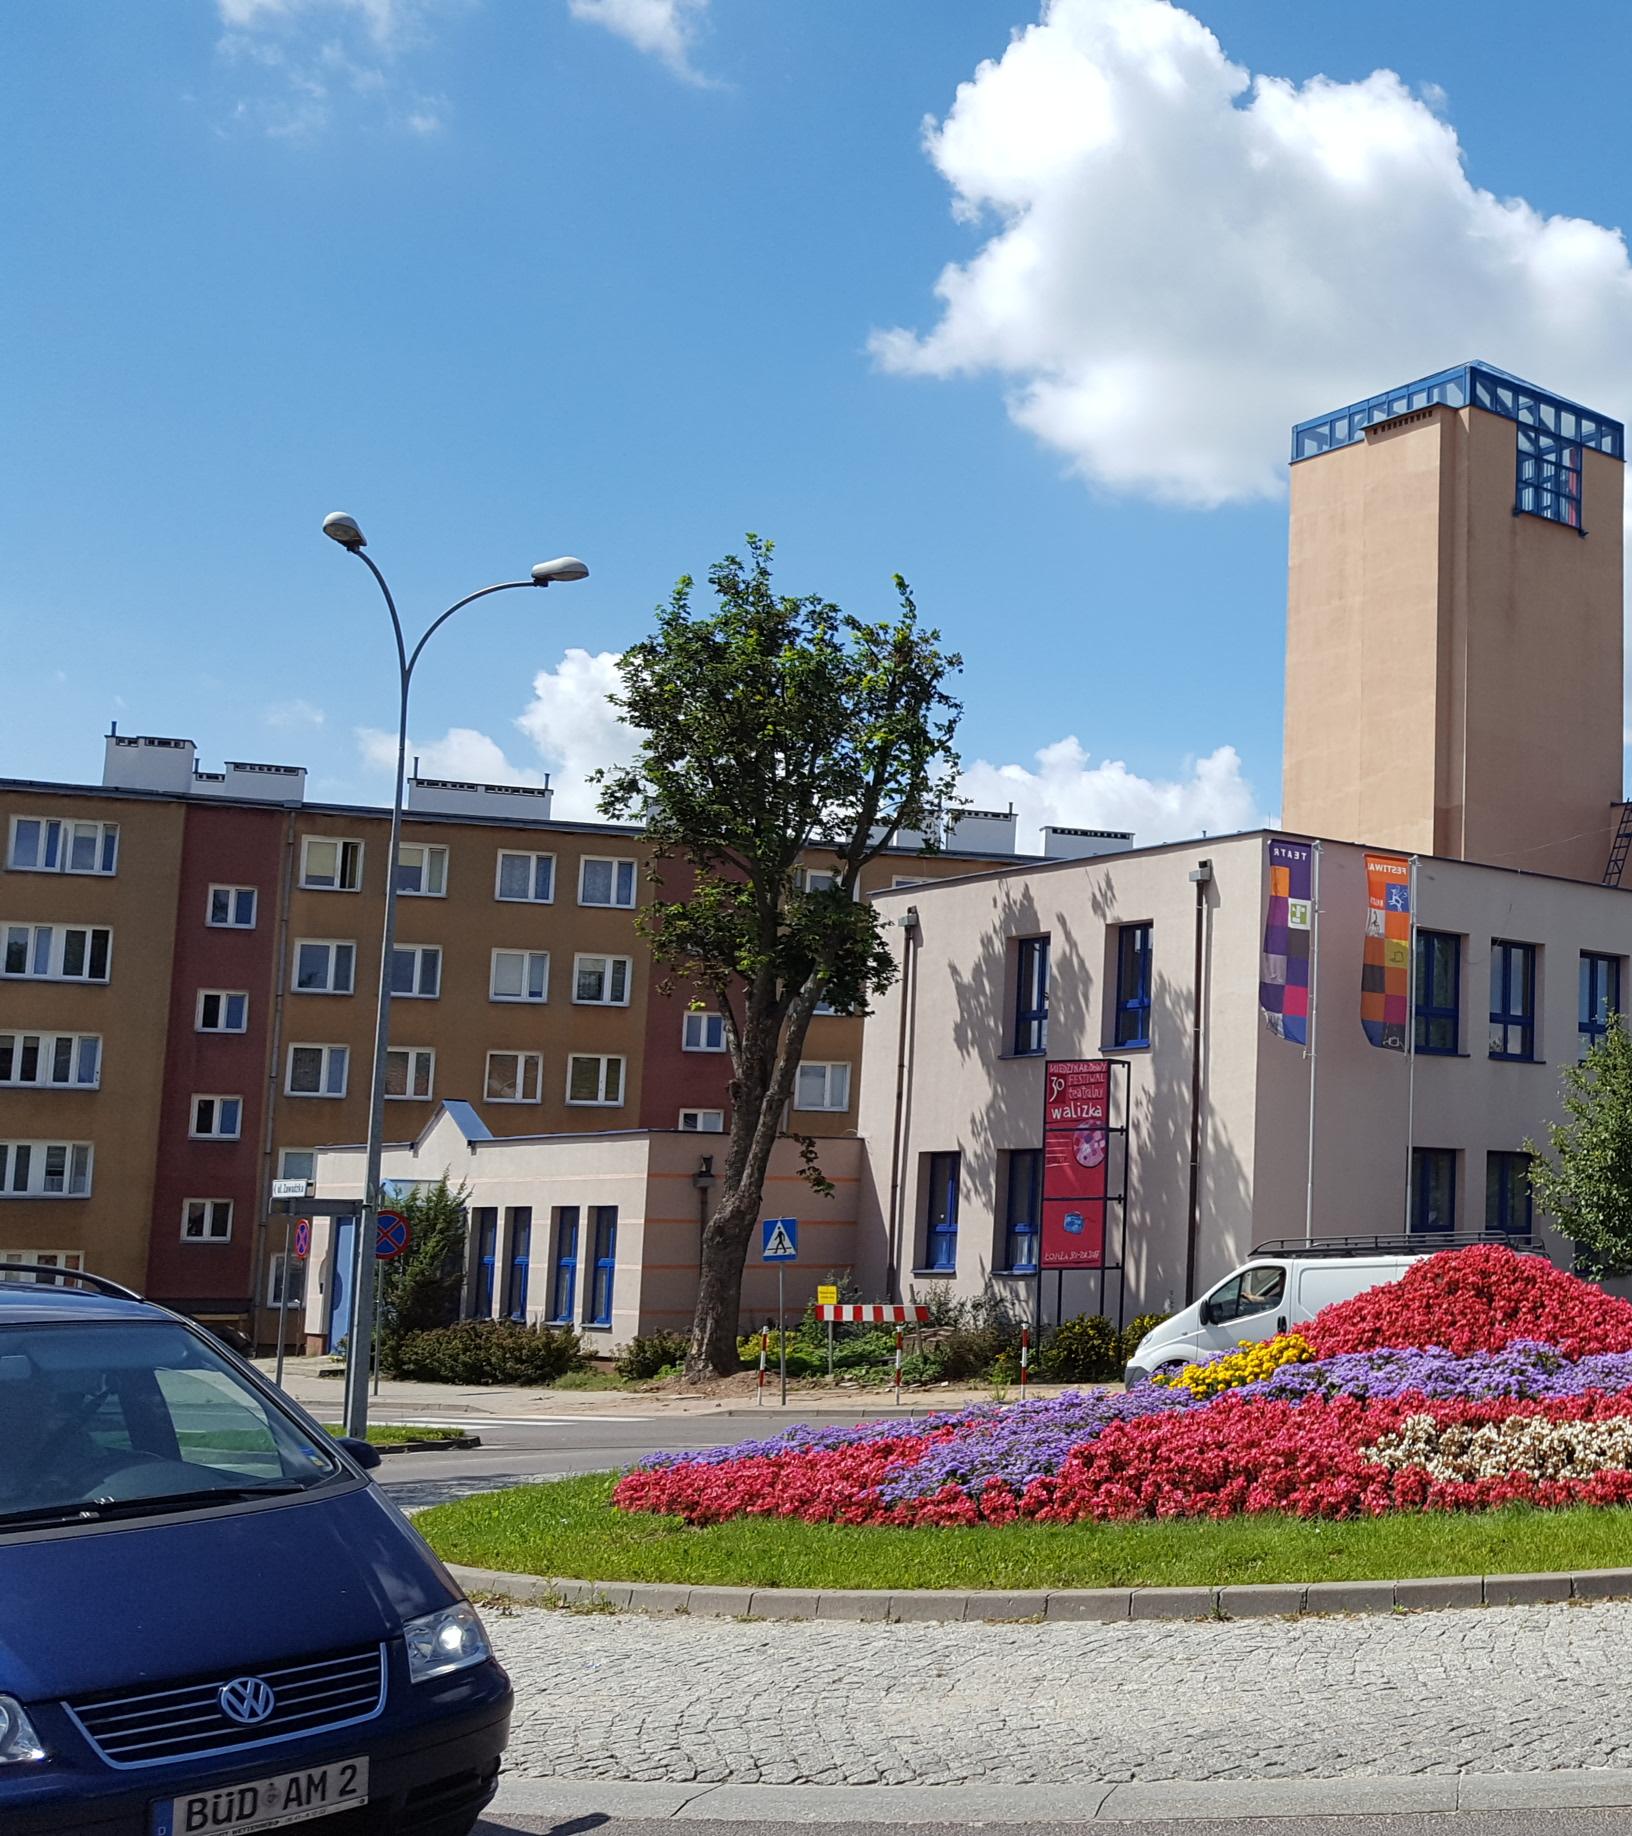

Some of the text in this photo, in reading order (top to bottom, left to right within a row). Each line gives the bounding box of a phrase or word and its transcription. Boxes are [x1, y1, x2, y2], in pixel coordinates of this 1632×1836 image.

[1049, 1077, 1065, 1102] 30
[1051, 1101, 1102, 1119] walizka
[186, 1764, 358, 1832] BÜD AM 2
[157, 1826, 167, 1836] D
